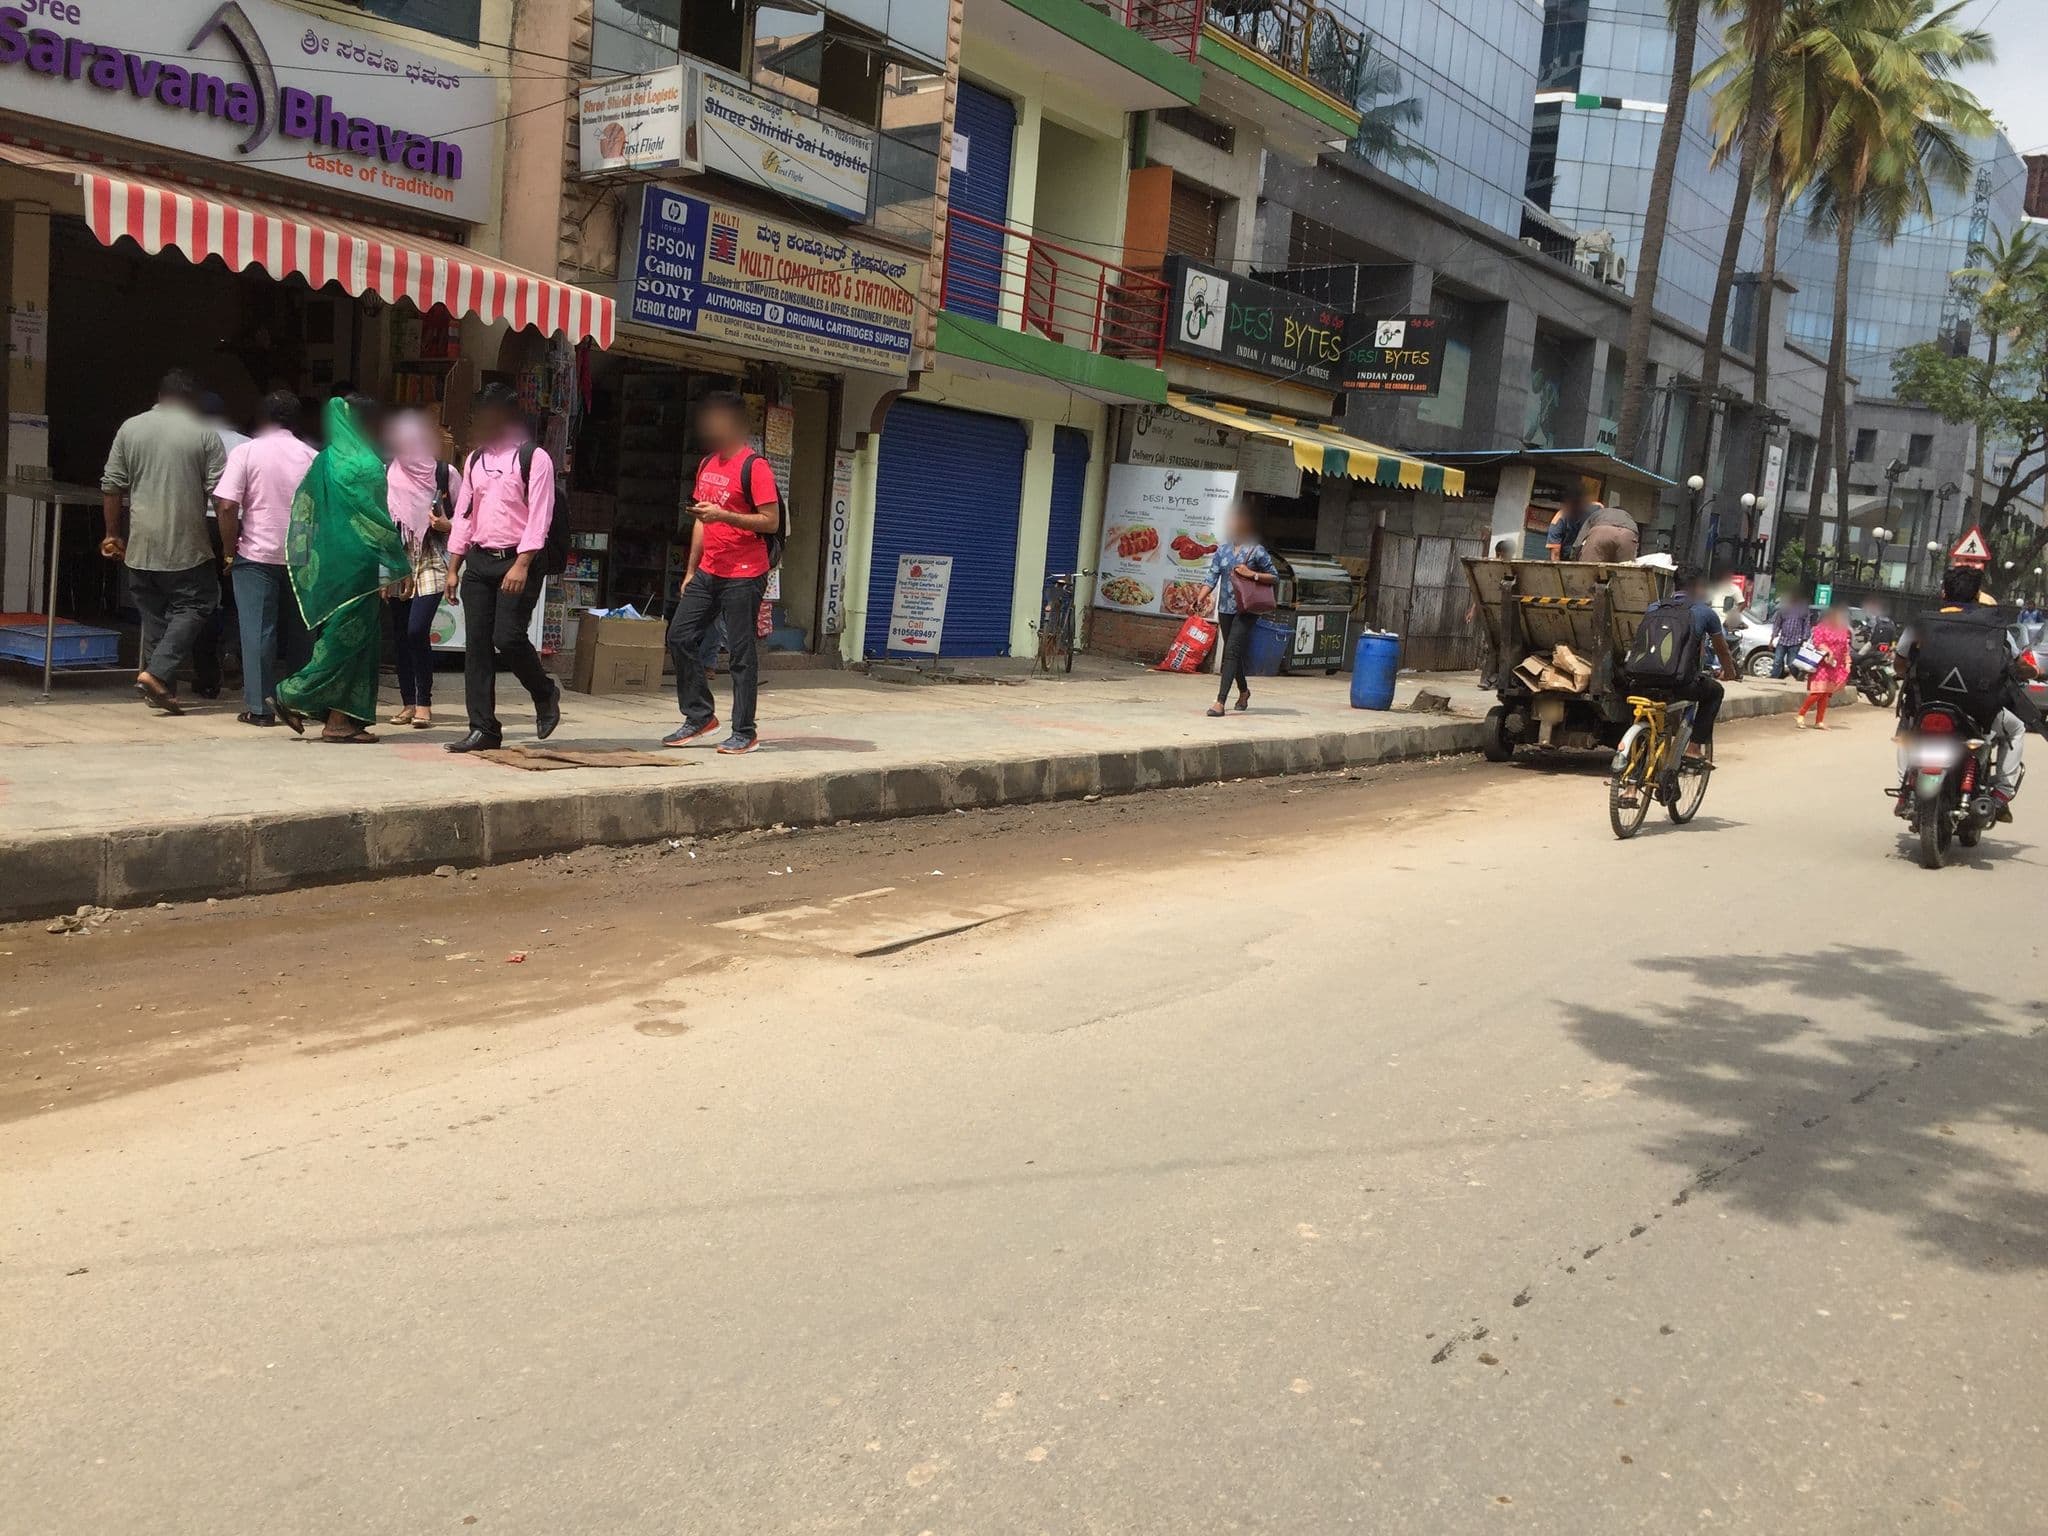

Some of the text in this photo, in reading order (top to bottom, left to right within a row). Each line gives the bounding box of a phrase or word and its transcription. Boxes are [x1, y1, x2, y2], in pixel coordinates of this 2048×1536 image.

[21, 0, 81, 25] Sree
[301, 28, 460, 90] ಶ್ರೀ ಸರವಣ ಭವನ್
[0, 6, 462, 180] Saravana Bhavan
[640, 136, 664, 155] Flight
[705, 96, 746, 127] Shree
[750, 114, 793, 145] Shiridi
[795, 133, 817, 154] Sai
[819, 143, 868, 173] Logistic
[307, 151, 454, 201] taste of tradition
[713, 211, 740, 229] MULTI
[647, 232, 695, 260] EPSON
[645, 255, 692, 280] Canon
[739, 248, 914, 316] MULTI COMPUTERS & STATIONERS
[637, 276, 694, 302] SONY
[708, 272, 732, 289] Dealers
[745, 280, 779, 300] COMPUTER
[780, 289, 823, 310] CONSUMABLES
[830, 301, 849, 317] OFFICE
[883, 313, 911, 330] SUPPLIERS
[635, 298, 692, 323] XEROX COPY
[706, 292, 762, 315] AUTHORISED
[787, 311, 824, 331] ORIGINAL
[826, 321, 873, 342] CARTRIDGES
[875, 332, 910, 350] SUPPLIER
[1229, 303, 1274, 343] DESI
[1284, 316, 1341, 361] BYTES
[1237, 345, 1258, 360] INDIAN
[1307, 365, 1330, 380] CHINESE
[1348, 350, 1430, 370] DESI BYTES
[1357, 371, 1415, 381] INDIAN FOOD
[1143, 495, 1164, 504] DESI
[1168, 495, 1199, 507] BYTES
[826, 500, 846, 629] COURIERS
[908, 620, 924, 629] Call
